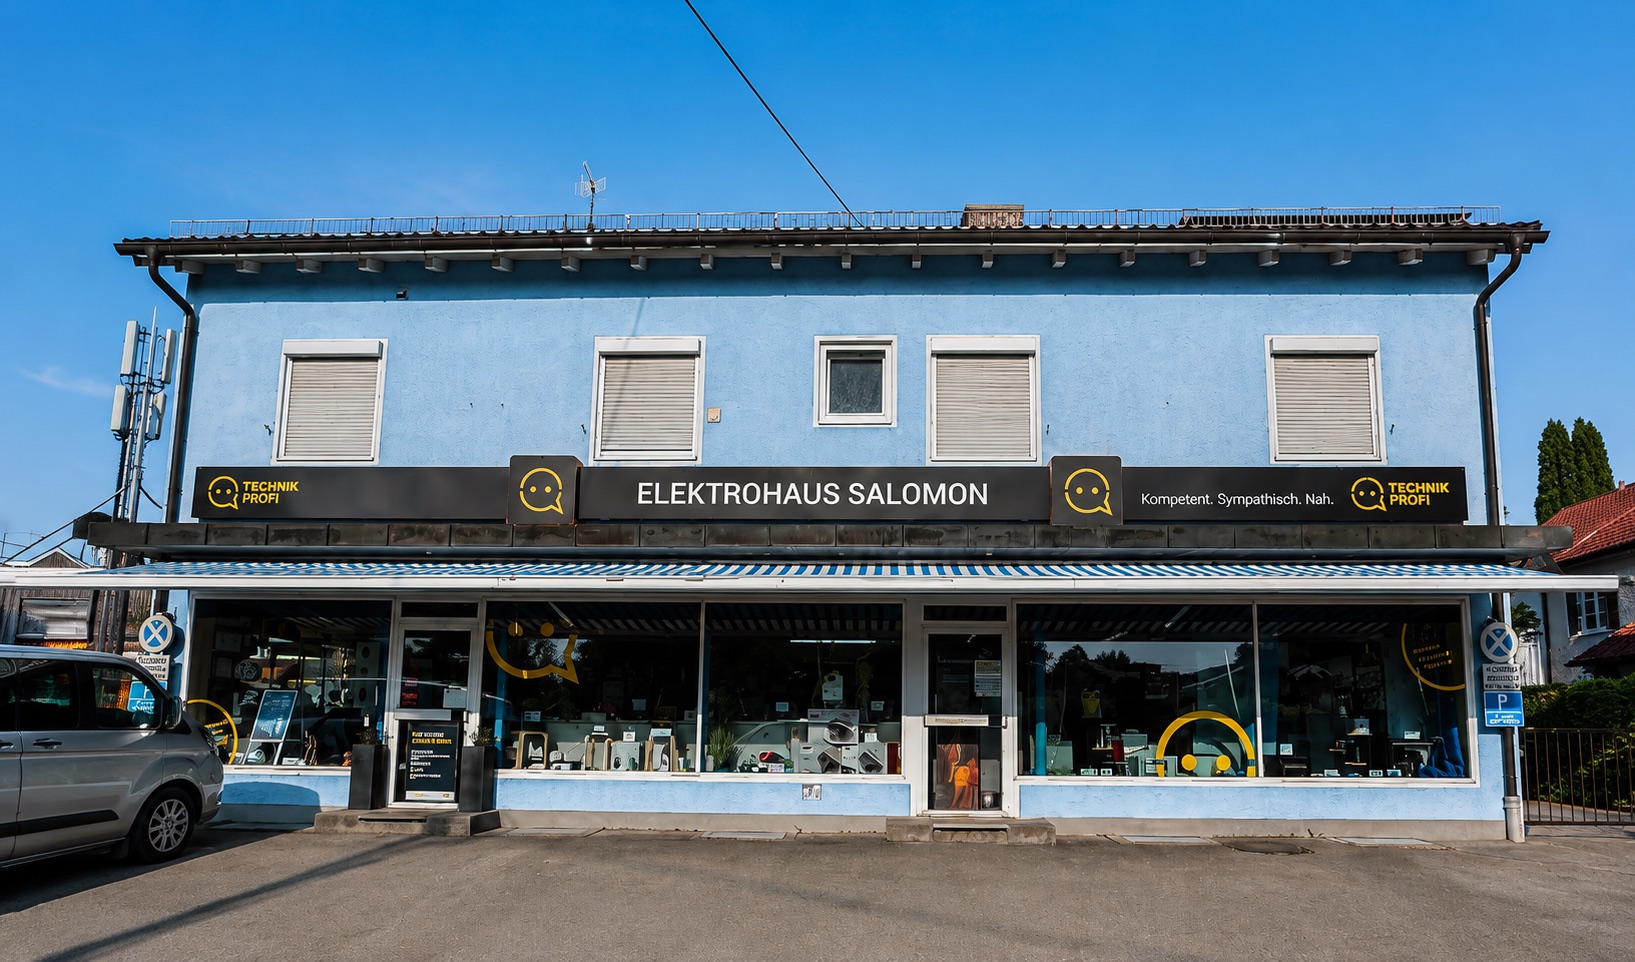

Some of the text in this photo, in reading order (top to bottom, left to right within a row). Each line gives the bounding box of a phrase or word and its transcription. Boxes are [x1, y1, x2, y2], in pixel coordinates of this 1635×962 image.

[242, 481, 299, 492] TECHNIK
[1388, 482, 1450, 493] TECHNIK
[242, 493, 279, 504] PROFI
[637, 482, 988, 505] ELEKTROHAUS SALOMON
[1141, 493, 1334, 507] Kompetent. Sympathisch. Nah.
[1389, 494, 1431, 506] PROFI
[1497, 693, 1508, 711] P
